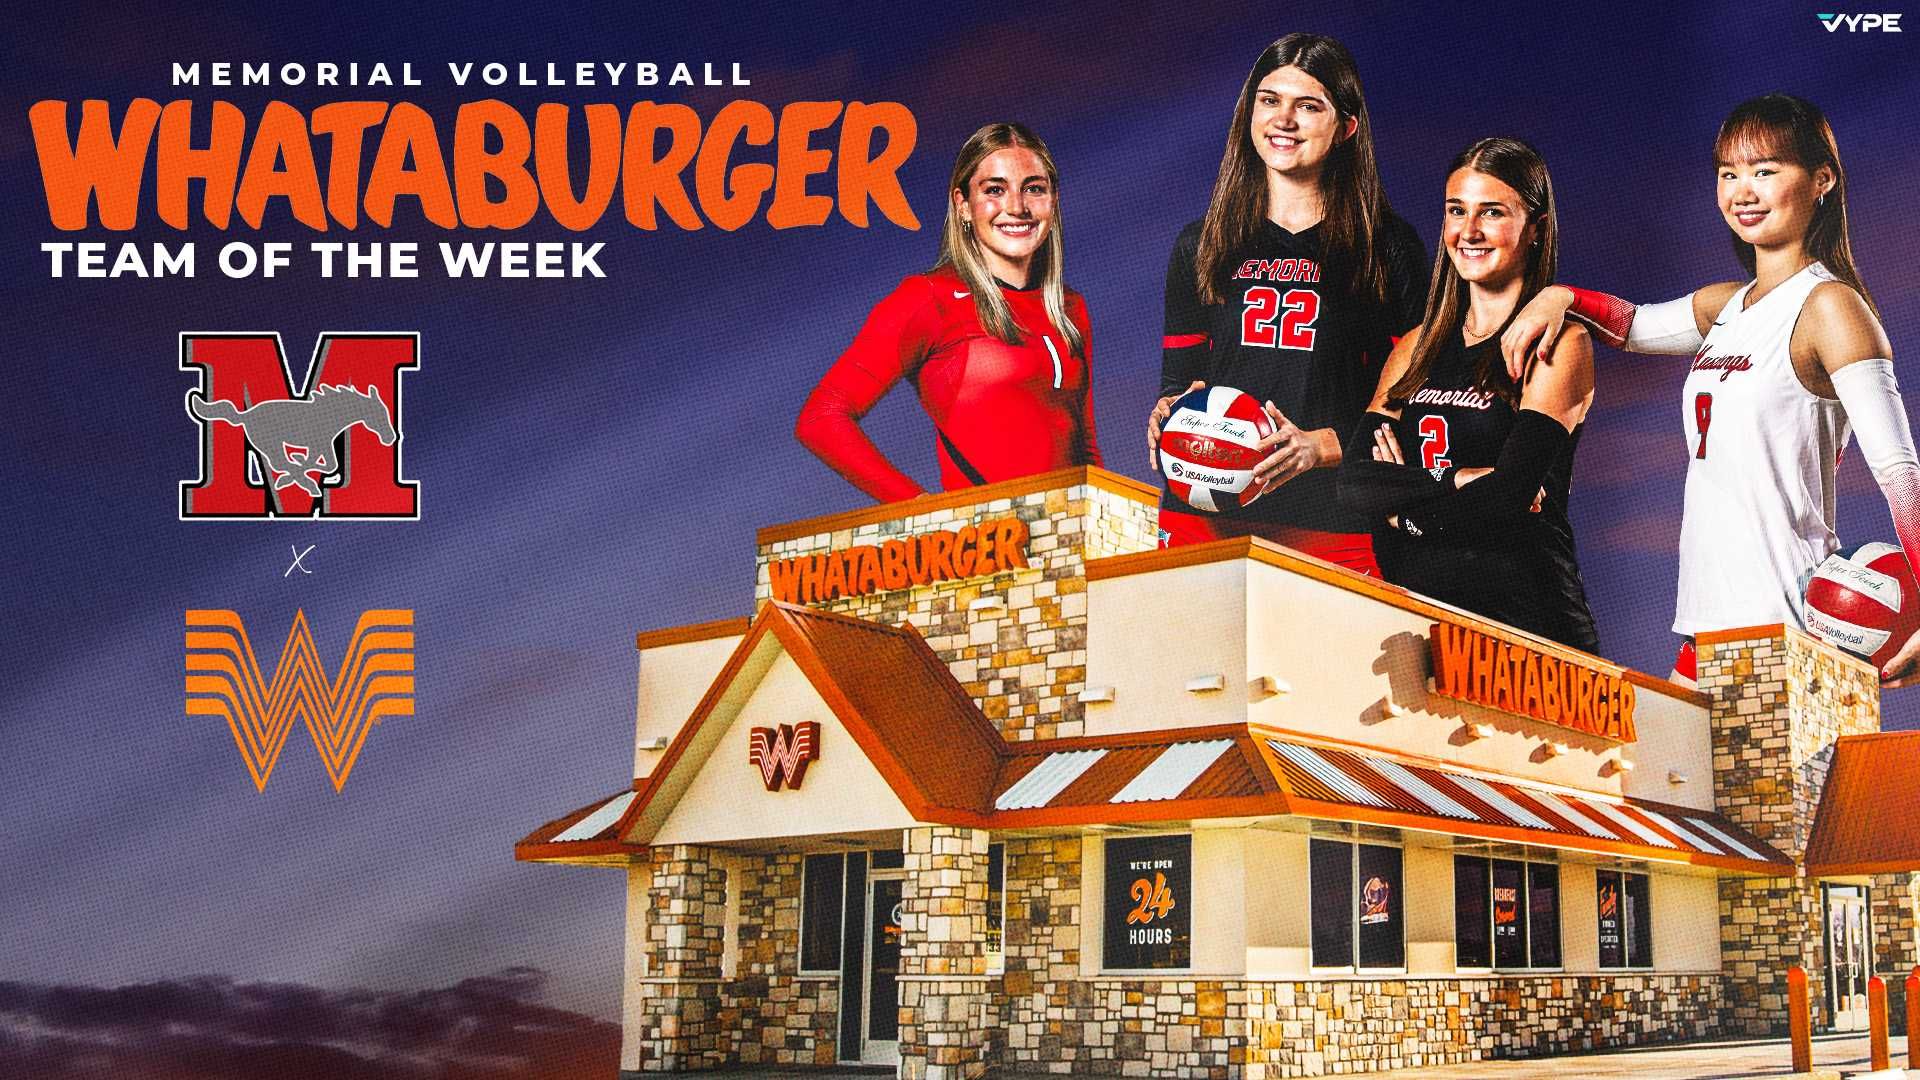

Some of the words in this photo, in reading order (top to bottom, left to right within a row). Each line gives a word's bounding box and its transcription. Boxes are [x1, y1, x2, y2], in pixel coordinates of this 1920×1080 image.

[1232, 258, 1320, 283] EMORI
[1241, 286, 1320, 351] 22
[1043, 335, 1063, 389] 1
[1418, 414, 1452, 469] 2
[1695, 392, 1713, 460] 9
[768, 518, 1030, 605] WHATABURGER
[1431, 622, 1638, 743] WHATABURGER
[1154, 860, 1173, 868] OPEN
[1127, 871, 1176, 924] 24
[1129, 928, 1172, 944] HOURS
